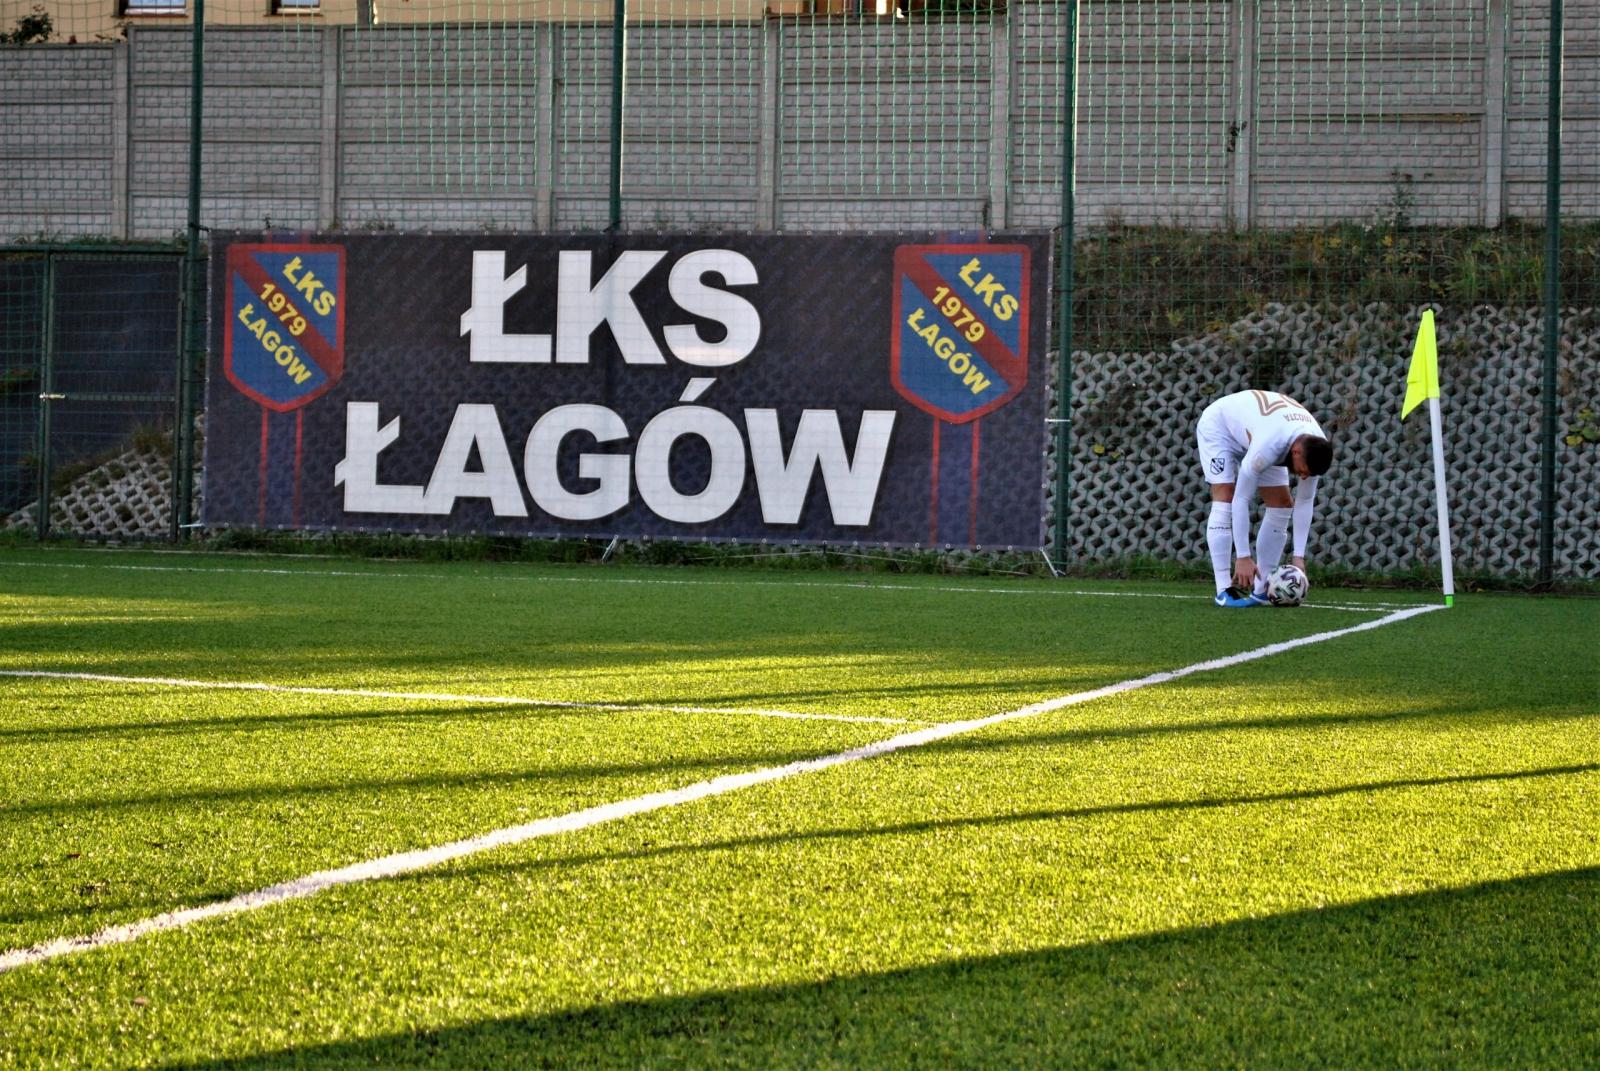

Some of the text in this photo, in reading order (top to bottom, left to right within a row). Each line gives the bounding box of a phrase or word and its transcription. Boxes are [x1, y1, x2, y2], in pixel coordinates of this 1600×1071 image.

[260, 282, 307, 336] 1979
[282, 256, 336, 316] ŁKS
[460, 248, 762, 367] ŁKS
[932, 286, 985, 343] 1979
[958, 257, 1020, 321] ŁKS
[238, 303, 313, 385] ŁAGÓW
[907, 307, 991, 395] ŁAGÓW
[334, 377, 897, 526] ŁAGÓW
